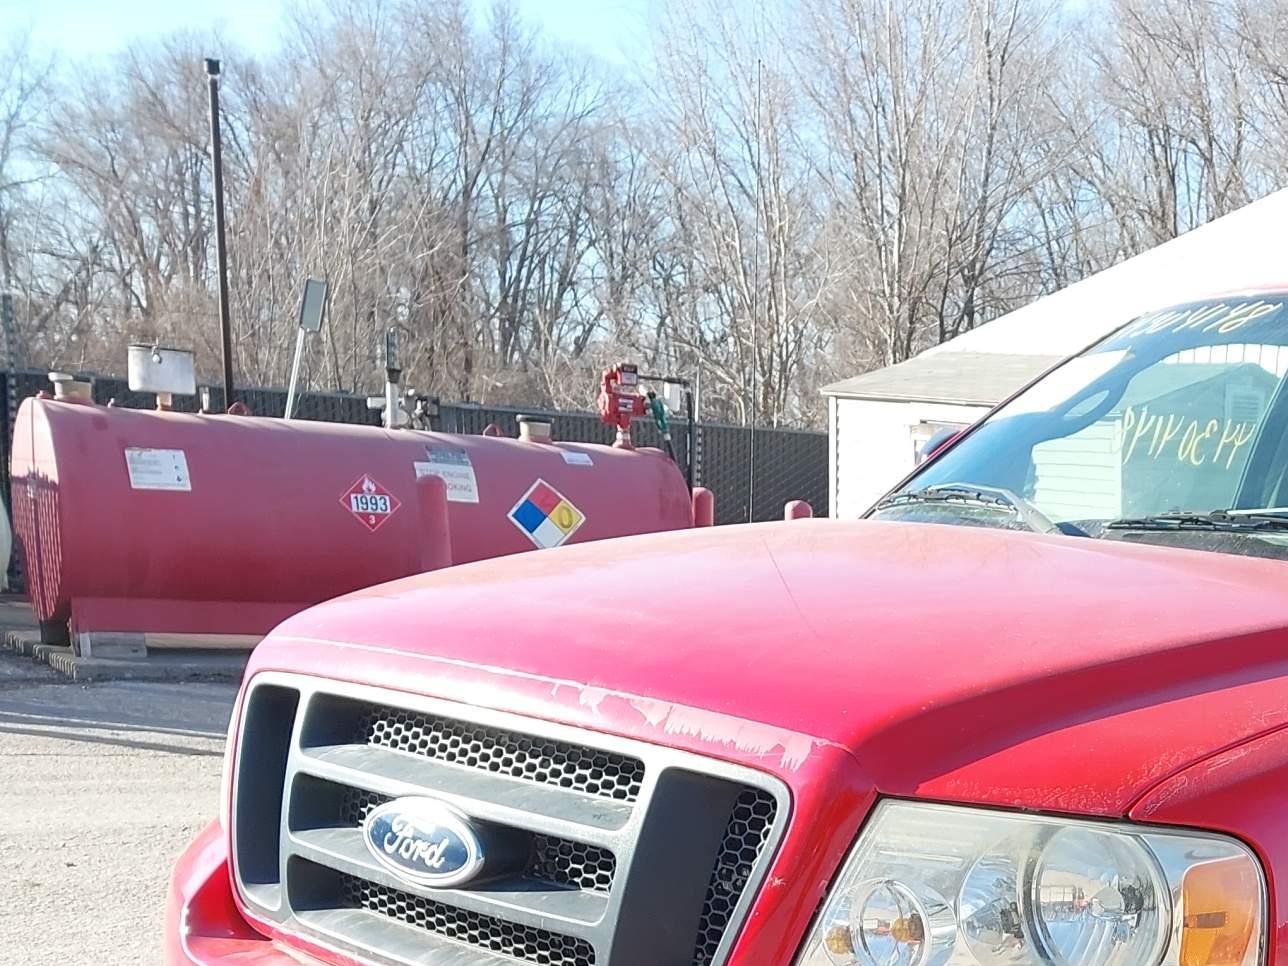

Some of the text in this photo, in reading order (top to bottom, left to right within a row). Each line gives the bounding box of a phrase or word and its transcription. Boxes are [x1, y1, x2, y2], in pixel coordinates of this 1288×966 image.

[447, 482, 473, 493] OKING
[353, 495, 388, 512] 1993
[368, 514, 376, 524] 3
[559, 505, 573, 529] 0
[384, 814, 449, 869] Ford
